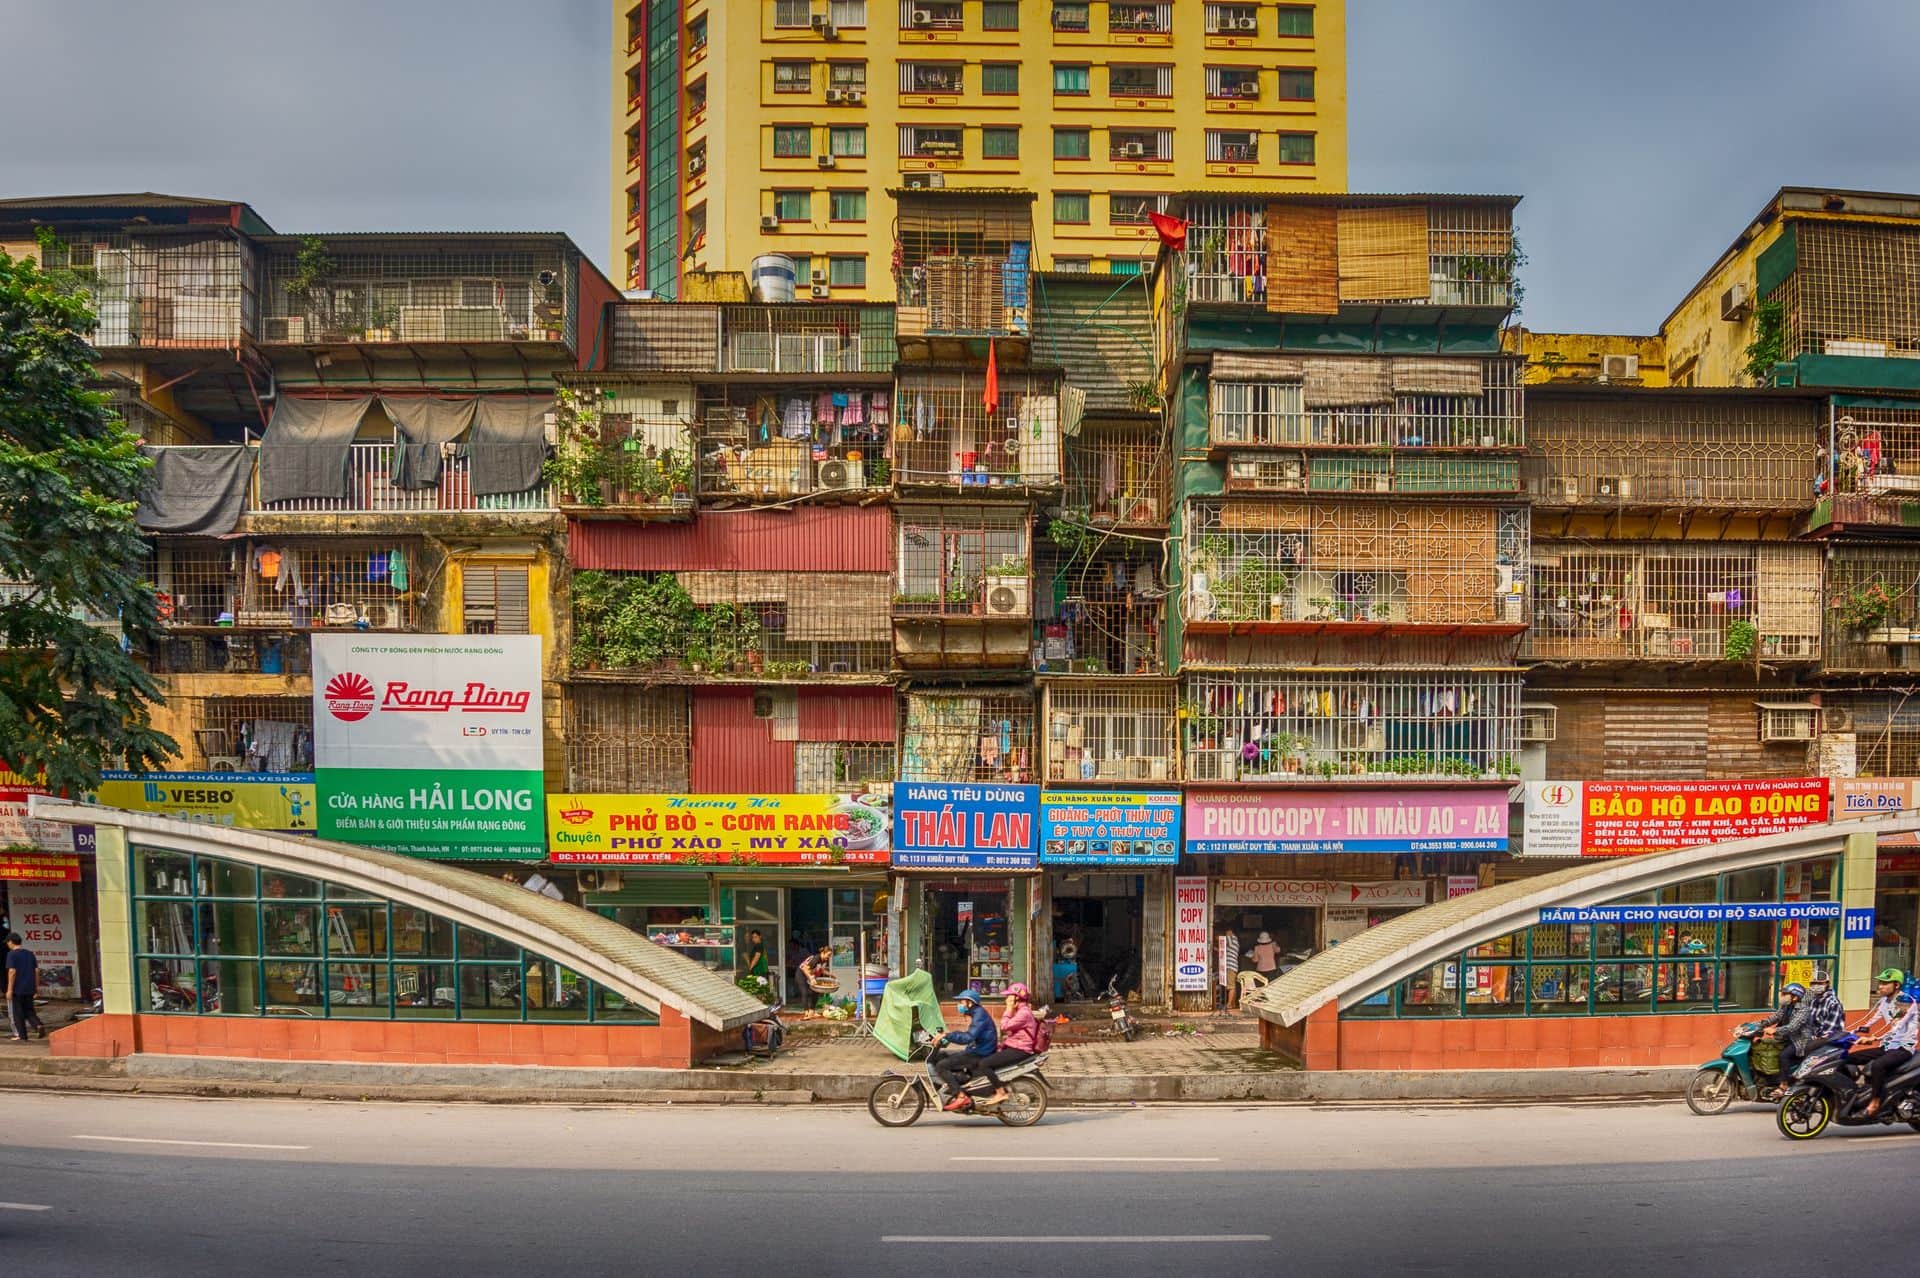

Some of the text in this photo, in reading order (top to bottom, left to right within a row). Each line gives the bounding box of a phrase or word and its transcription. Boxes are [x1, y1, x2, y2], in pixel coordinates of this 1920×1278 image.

[463, 727, 487, 737] LED
[1589, 784, 1612, 792] CÔNG
[1650, 784, 1681, 792] THƯƠNG
[1683, 785, 1698, 793] MẠI
[1719, 784, 1730, 793] VỤ
[1731, 782, 1742, 791] VÀ
[1755, 781, 1771, 791] VẤN
[1772, 782, 1799, 790] HOÀNG
[1800, 781, 1822, 789] LONG
[171, 789, 235, 805] VESBO
[328, 782, 533, 811] CỬA HÀNG HẢI LONG
[908, 787, 1025, 803] HÀNG TIÊU DÙNG
[1046, 794, 1062, 802] CỬA
[1230, 794, 1262, 804] DOANH
[1846, 792, 1902, 811] Tiến Đạt
[1588, 792, 1820, 820] BẢO HỘ LAO ĐỘNG
[609, 807, 850, 831] PHỞ BÒ CƠM RANG
[1154, 808, 1174, 825] LỰC
[1203, 807, 1326, 836] PHOTOCOPY
[1346, 807, 1369, 835] IN
[1375, 801, 1422, 835] MÀU
[1473, 805, 1501, 834] A4
[336, 817, 357, 829] ĐIỂM
[358, 818, 376, 830] BÁN
[377, 819, 385, 830] &
[386, 817, 402, 830] GIỚI
[406, 817, 430, 832] THIỆU
[432, 817, 449, 831] SẢN
[450, 817, 476, 831] PHẨM
[901, 804, 1031, 849] THÁI LAN
[1595, 820, 1623, 829] DỤNG
[1625, 820, 1640, 829] CỤ
[1667, 820, 1683, 828] TAY
[556, 831, 601, 845] Chuyên
[1071, 826, 1094, 837] TUY
[1145, 826, 1168, 839] LỰC
[1641, 829, 1660, 838] NỘI
[1661, 827, 1686, 836] THẤT
[1688, 828, 1709, 836] HÀN
[611, 832, 664, 849] PHỞ
[672, 835, 722, 849] XÀO
[798, 834, 849, 849] XÀO
[1595, 838, 1614, 847] BẠT
[1616, 838, 1644, 846] CÔNG
[1178, 888, 1206, 904] PHOTO
[1221, 881, 1422, 898] PHOTOCOPY A4
[1235, 893, 1250, 903] IN
[24, 914, 61, 925] XE GA
[1180, 908, 1204, 923] COPY
[1541, 904, 1840, 921] HẦM DÀNH CHO NGƯỜI ĐI BỘ SANG ĐƯỜNG
[1847, 915, 1871, 931] H11
[26, 926, 63, 941] XE SỐ
[1178, 925, 1206, 943] IN MÀU
[1195, 948, 1205, 963] A4
